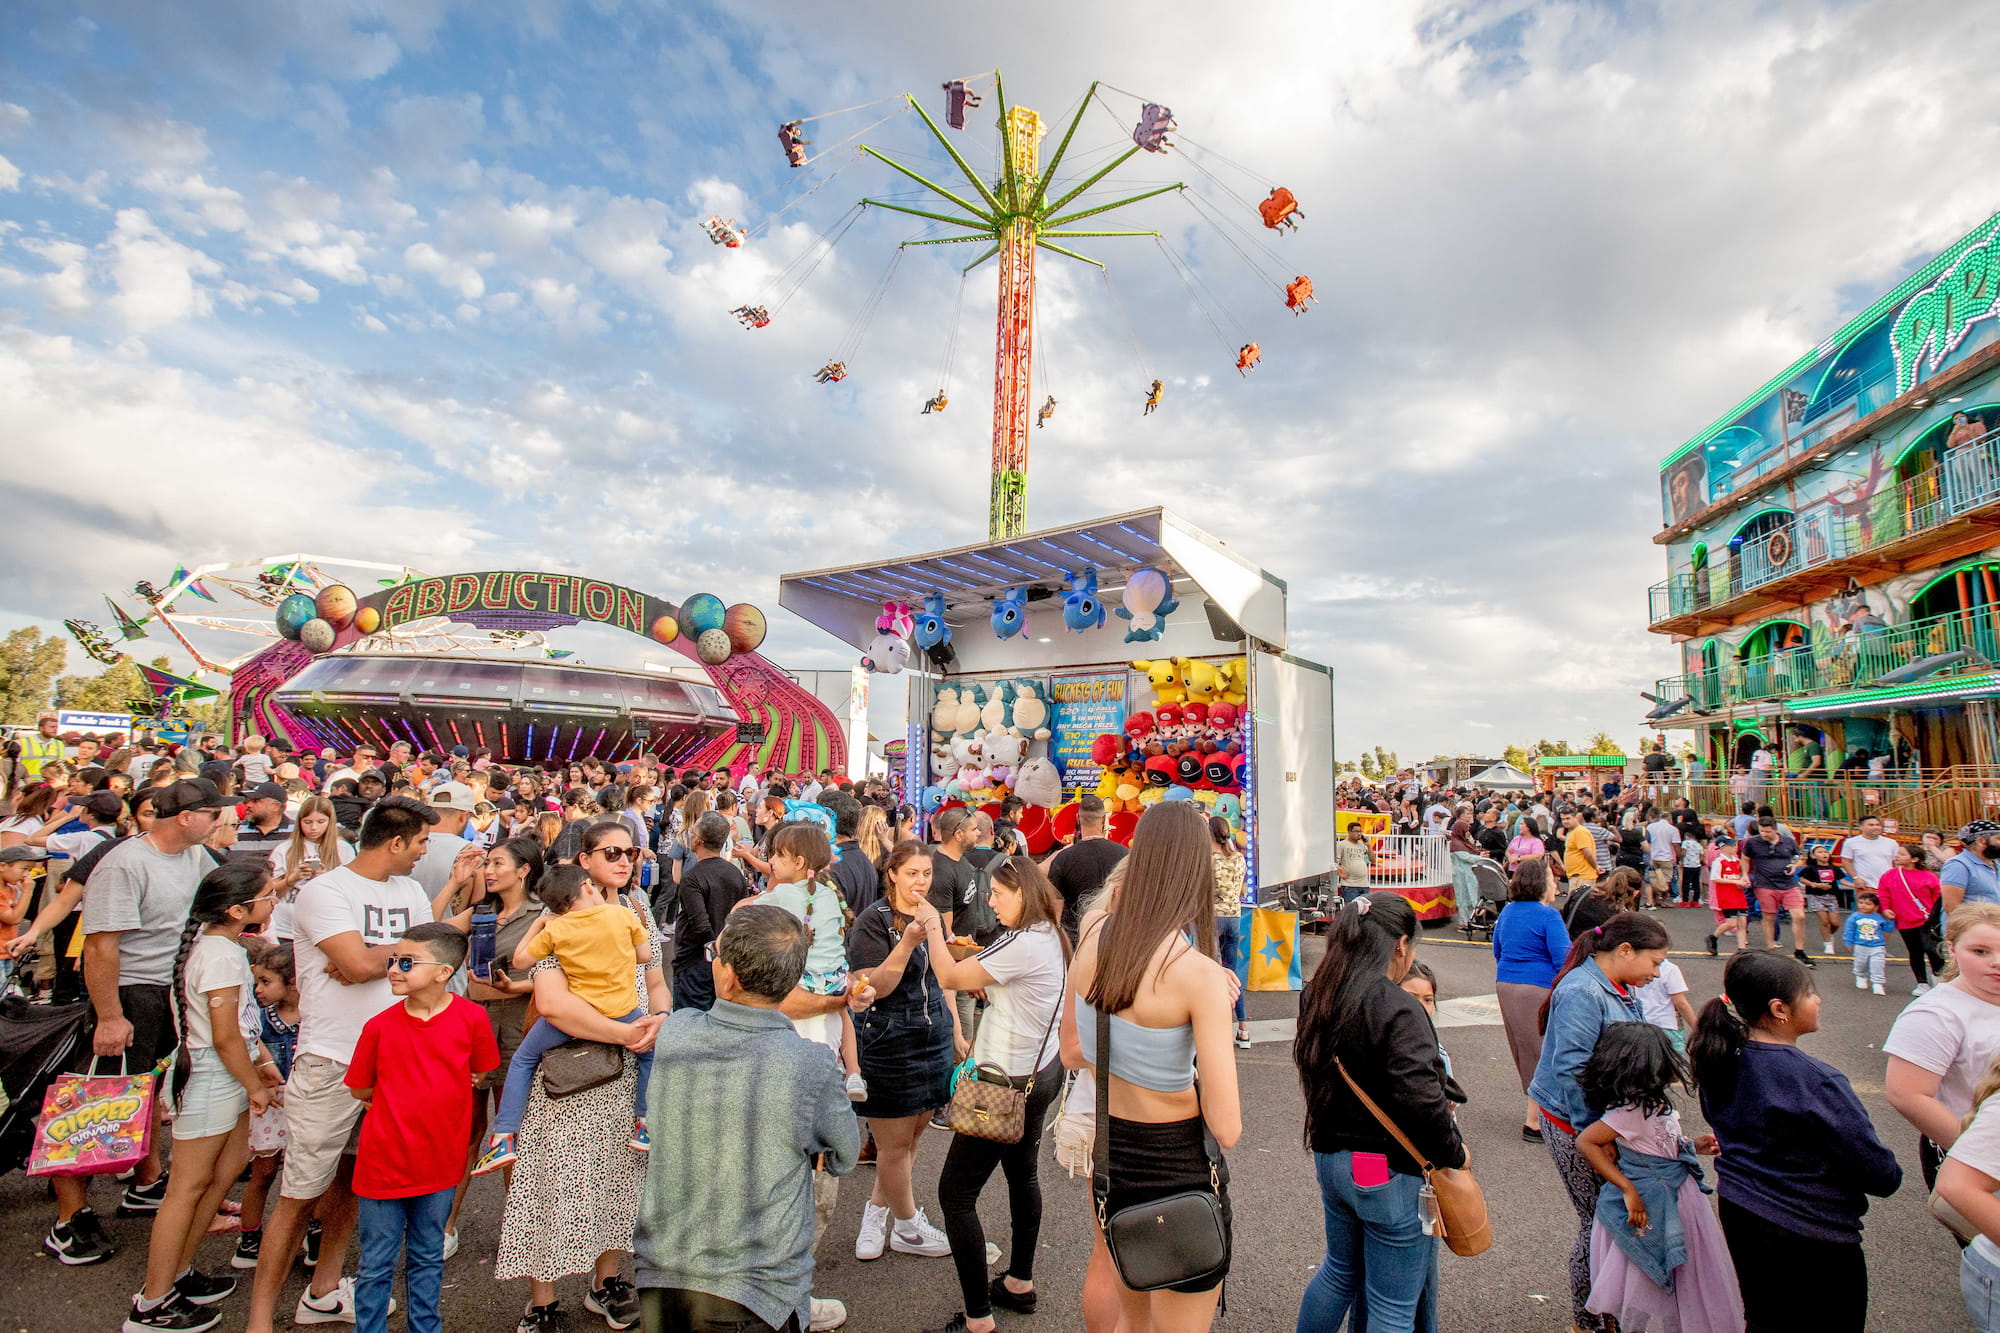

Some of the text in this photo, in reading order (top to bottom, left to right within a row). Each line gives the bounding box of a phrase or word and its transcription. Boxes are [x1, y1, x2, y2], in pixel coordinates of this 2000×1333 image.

[384, 572, 645, 635] ABDUCTION
[1054, 679, 1125, 703] BUCKETS OF FUN
[1060, 707, 1079, 716] $20
[136, 717, 188, 730] TICKETS
[1064, 731, 1081, 740] $10
[46, 1097, 141, 1142] RIPPER
